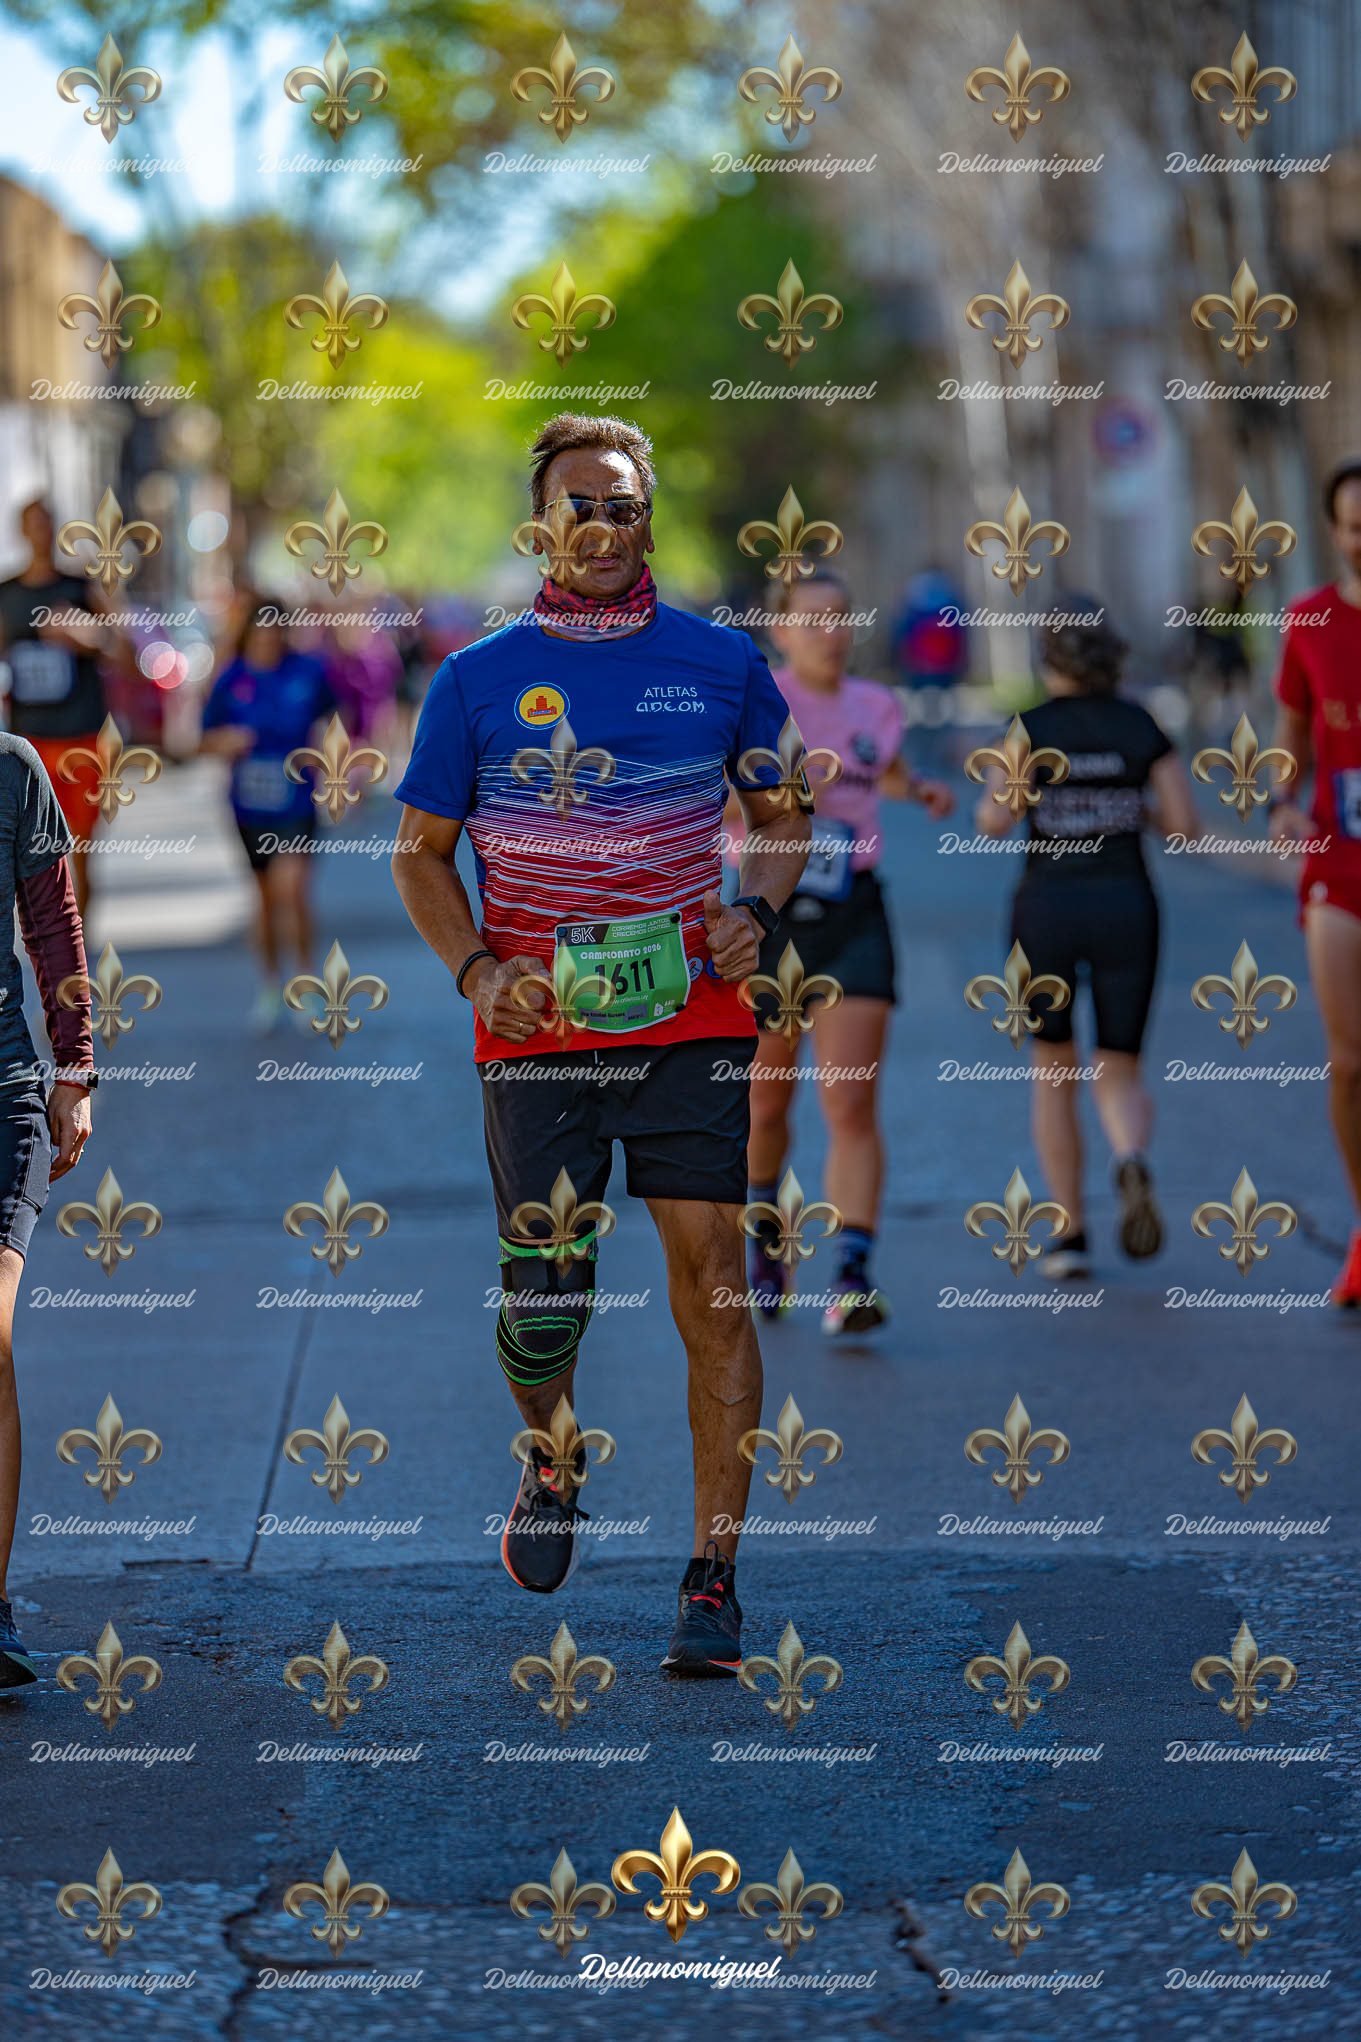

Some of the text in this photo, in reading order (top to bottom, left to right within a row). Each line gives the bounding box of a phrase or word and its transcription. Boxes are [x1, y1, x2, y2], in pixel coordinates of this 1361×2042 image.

[643, 686, 698, 698] ATLETAS
[571, 926, 596, 944] 5K
[580, 943, 662, 960] CAMPEONATO 2026
[594, 957, 655, 996] 1611
